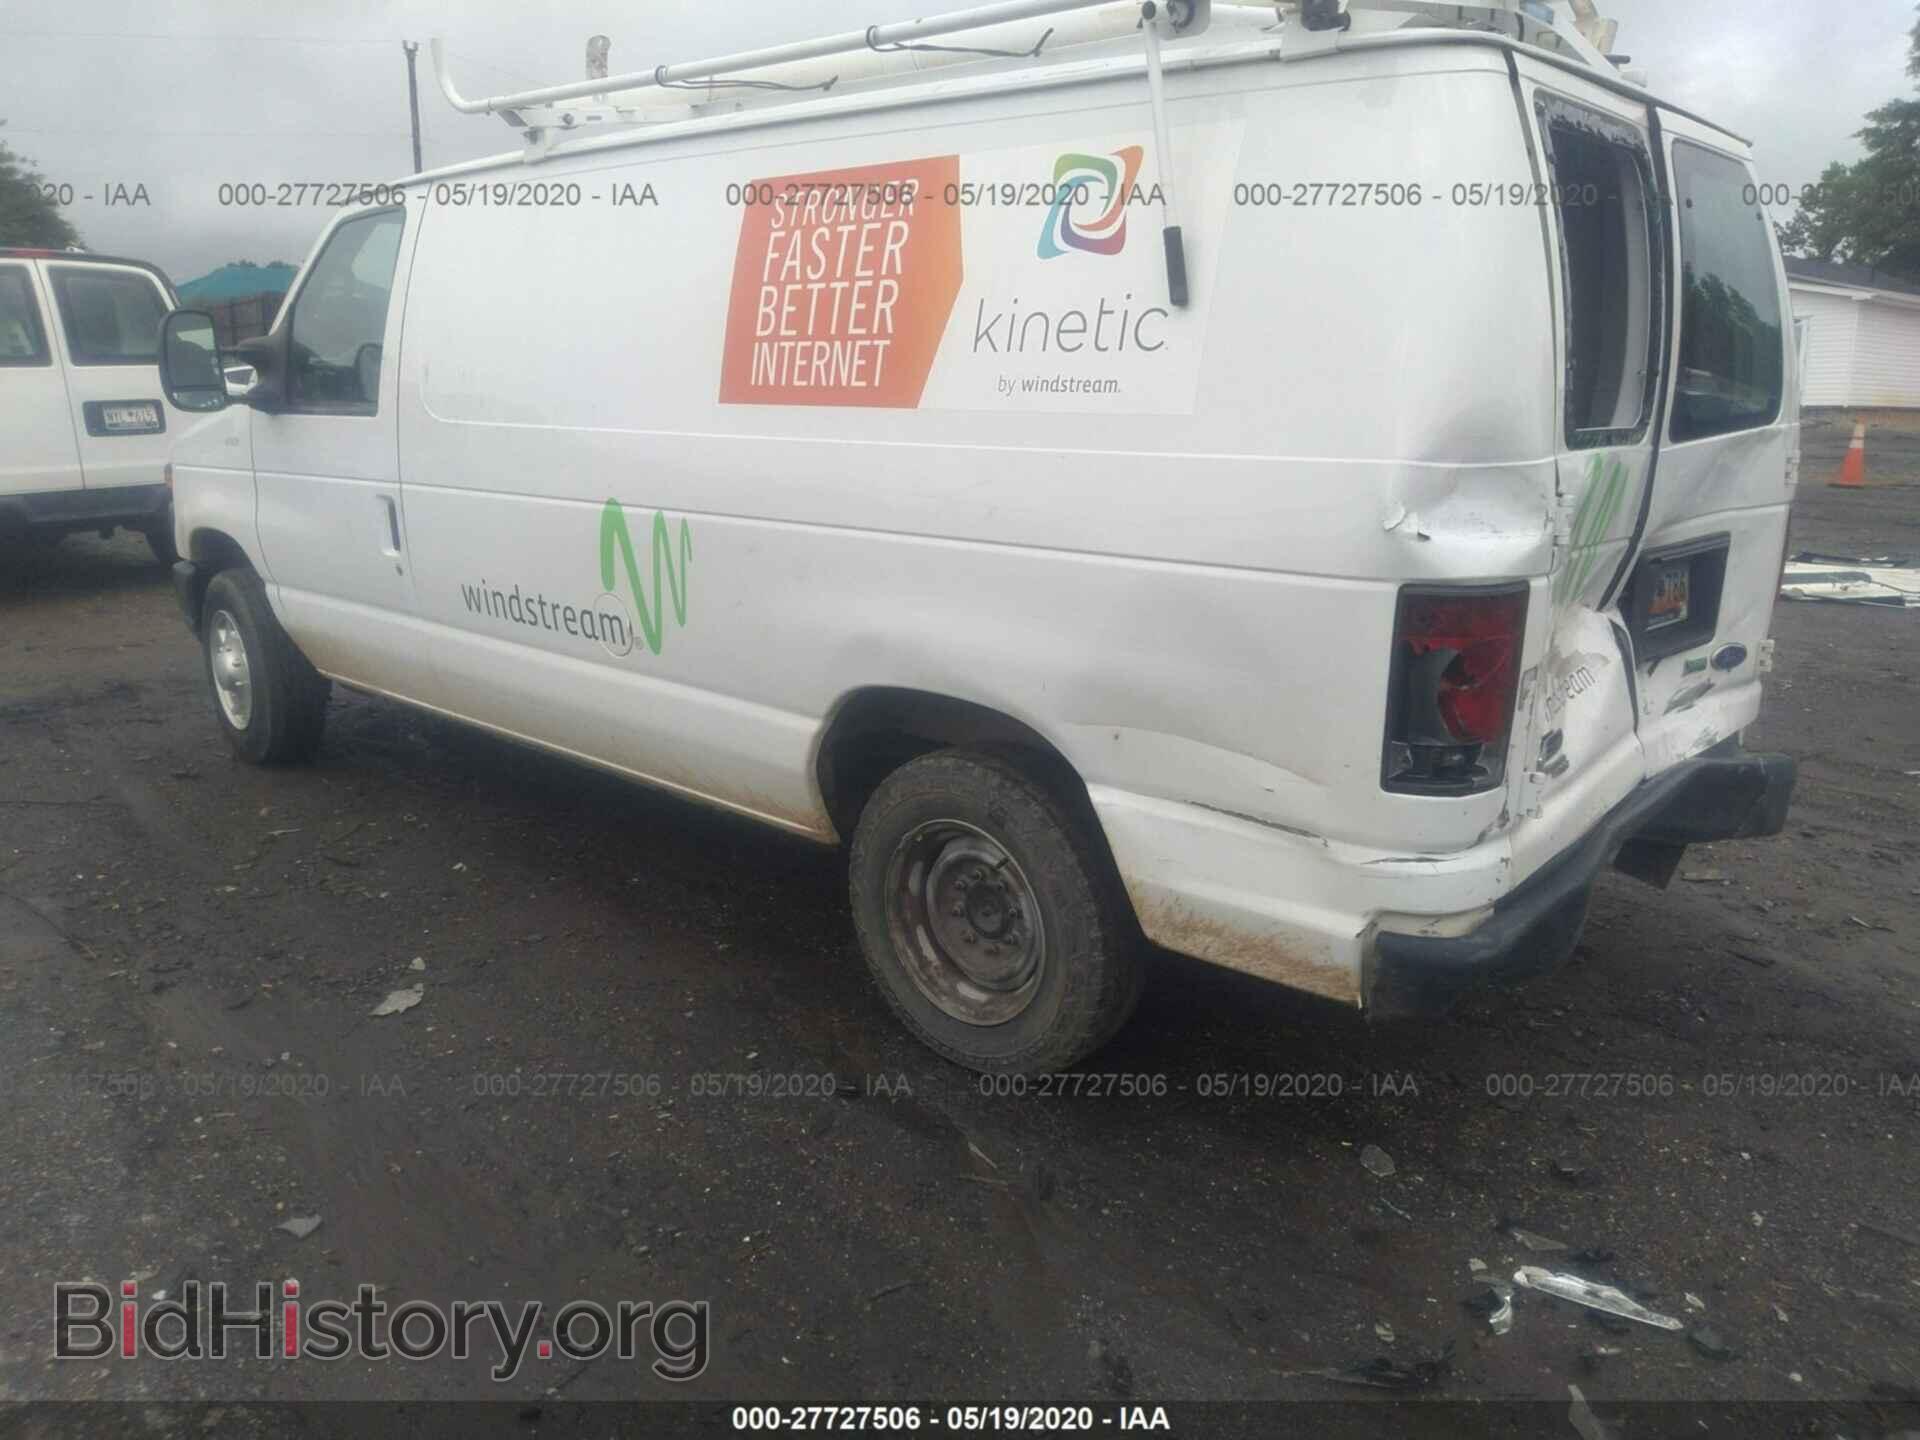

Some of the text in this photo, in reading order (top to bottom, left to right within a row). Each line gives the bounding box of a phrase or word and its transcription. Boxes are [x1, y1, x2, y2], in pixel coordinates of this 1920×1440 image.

[770, 178, 920, 229] STRONGER
[762, 221, 910, 283] FASTER
[756, 278, 899, 337] BETTER
[972, 293, 1168, 352] kinetic
[751, 339, 891, 387] INTERNET
[997, 374, 1016, 397] by
[460, 578, 628, 646] windstream
